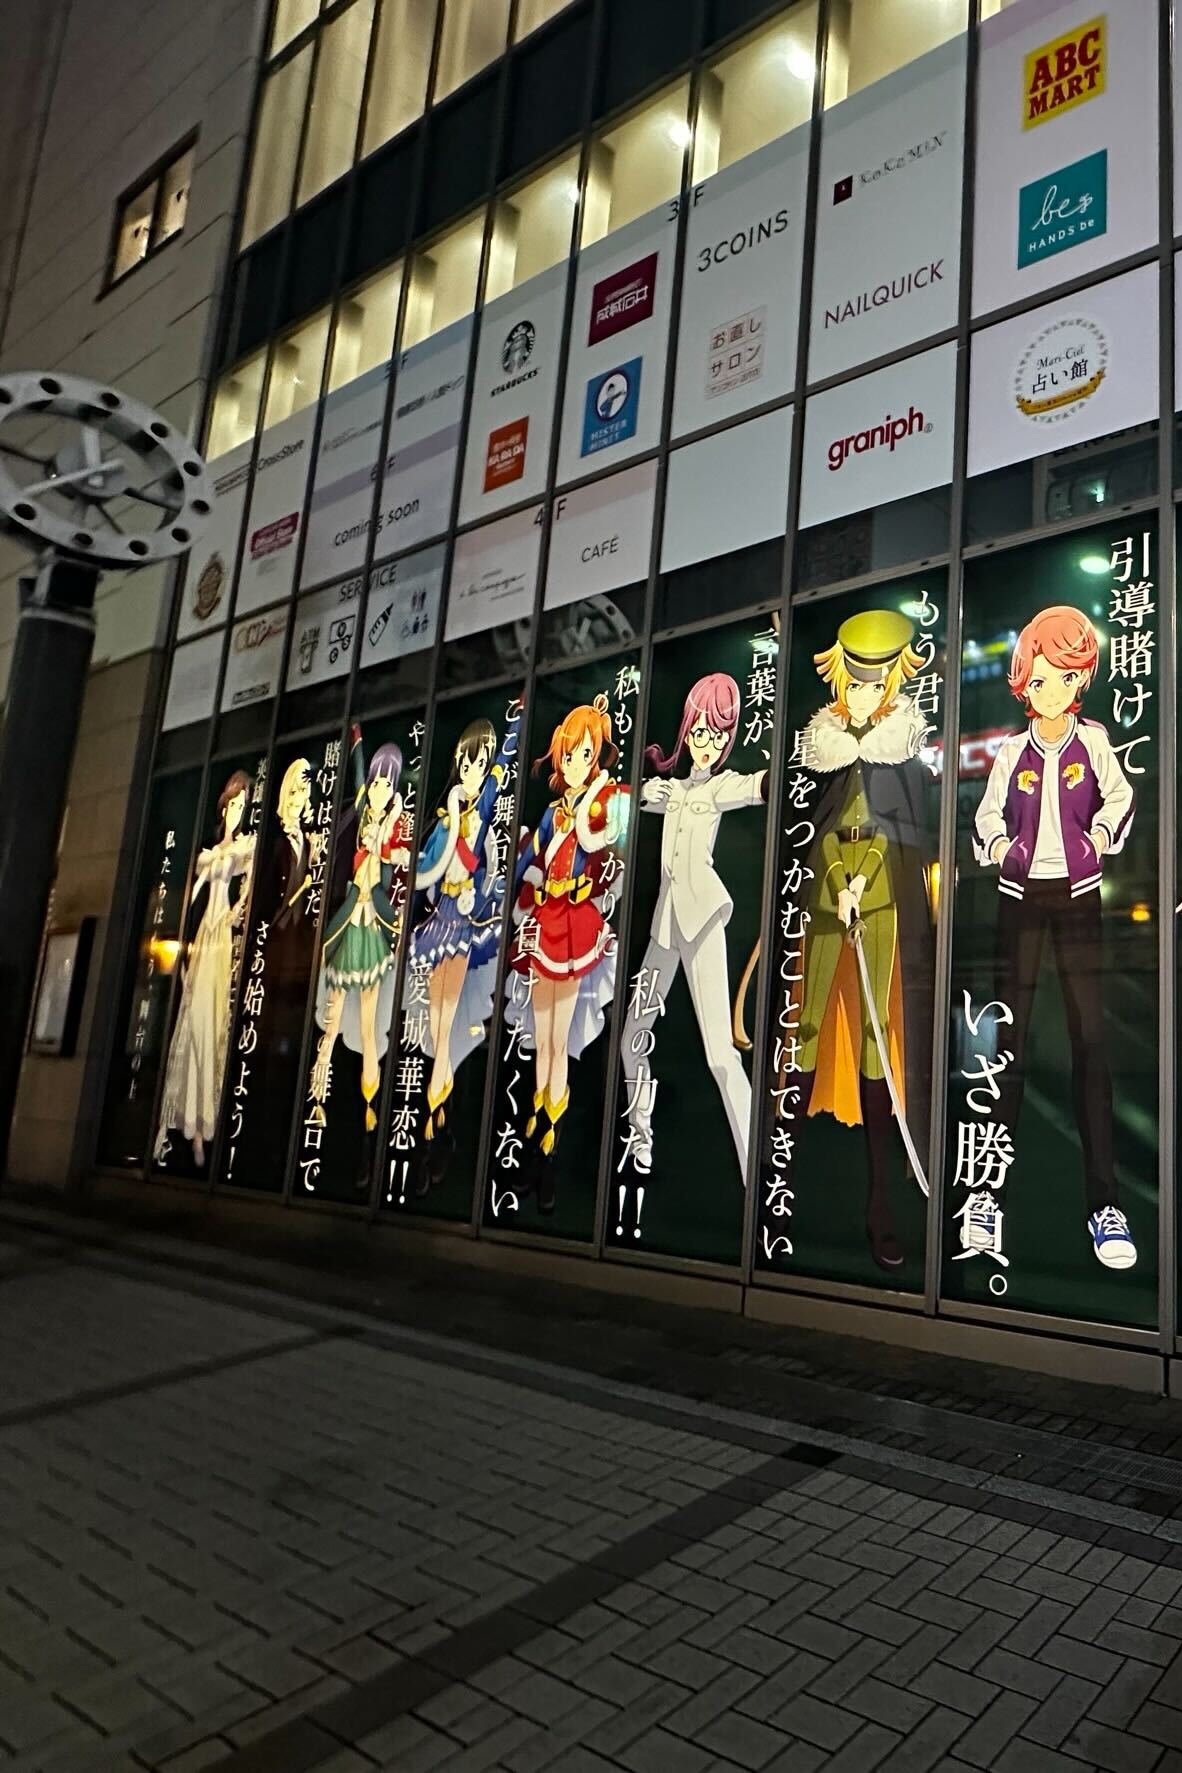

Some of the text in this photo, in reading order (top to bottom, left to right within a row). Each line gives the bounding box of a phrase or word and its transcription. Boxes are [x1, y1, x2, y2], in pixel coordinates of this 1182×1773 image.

[1030, 26, 1101, 91] ABC
[1028, 64, 1100, 120] MART
[697, 210, 789, 272] 3COINS
[1028, 225, 1075, 252] HANDS
[824, 259, 944, 330] NAILQUICK
[710, 344, 761, 378] サロン
[713, 315, 762, 351] お直し
[1032, 359, 1089, 394] 占い館
[1107, 532, 1156, 776] 引導賭けて
[743, 628, 780, 760] 言葉が、
[763, 727, 820, 1260] 星をつかむことはできない
[491, 916, 542, 1218] 負けたくない
[952, 989, 1016, 1296] いざ勝負。
